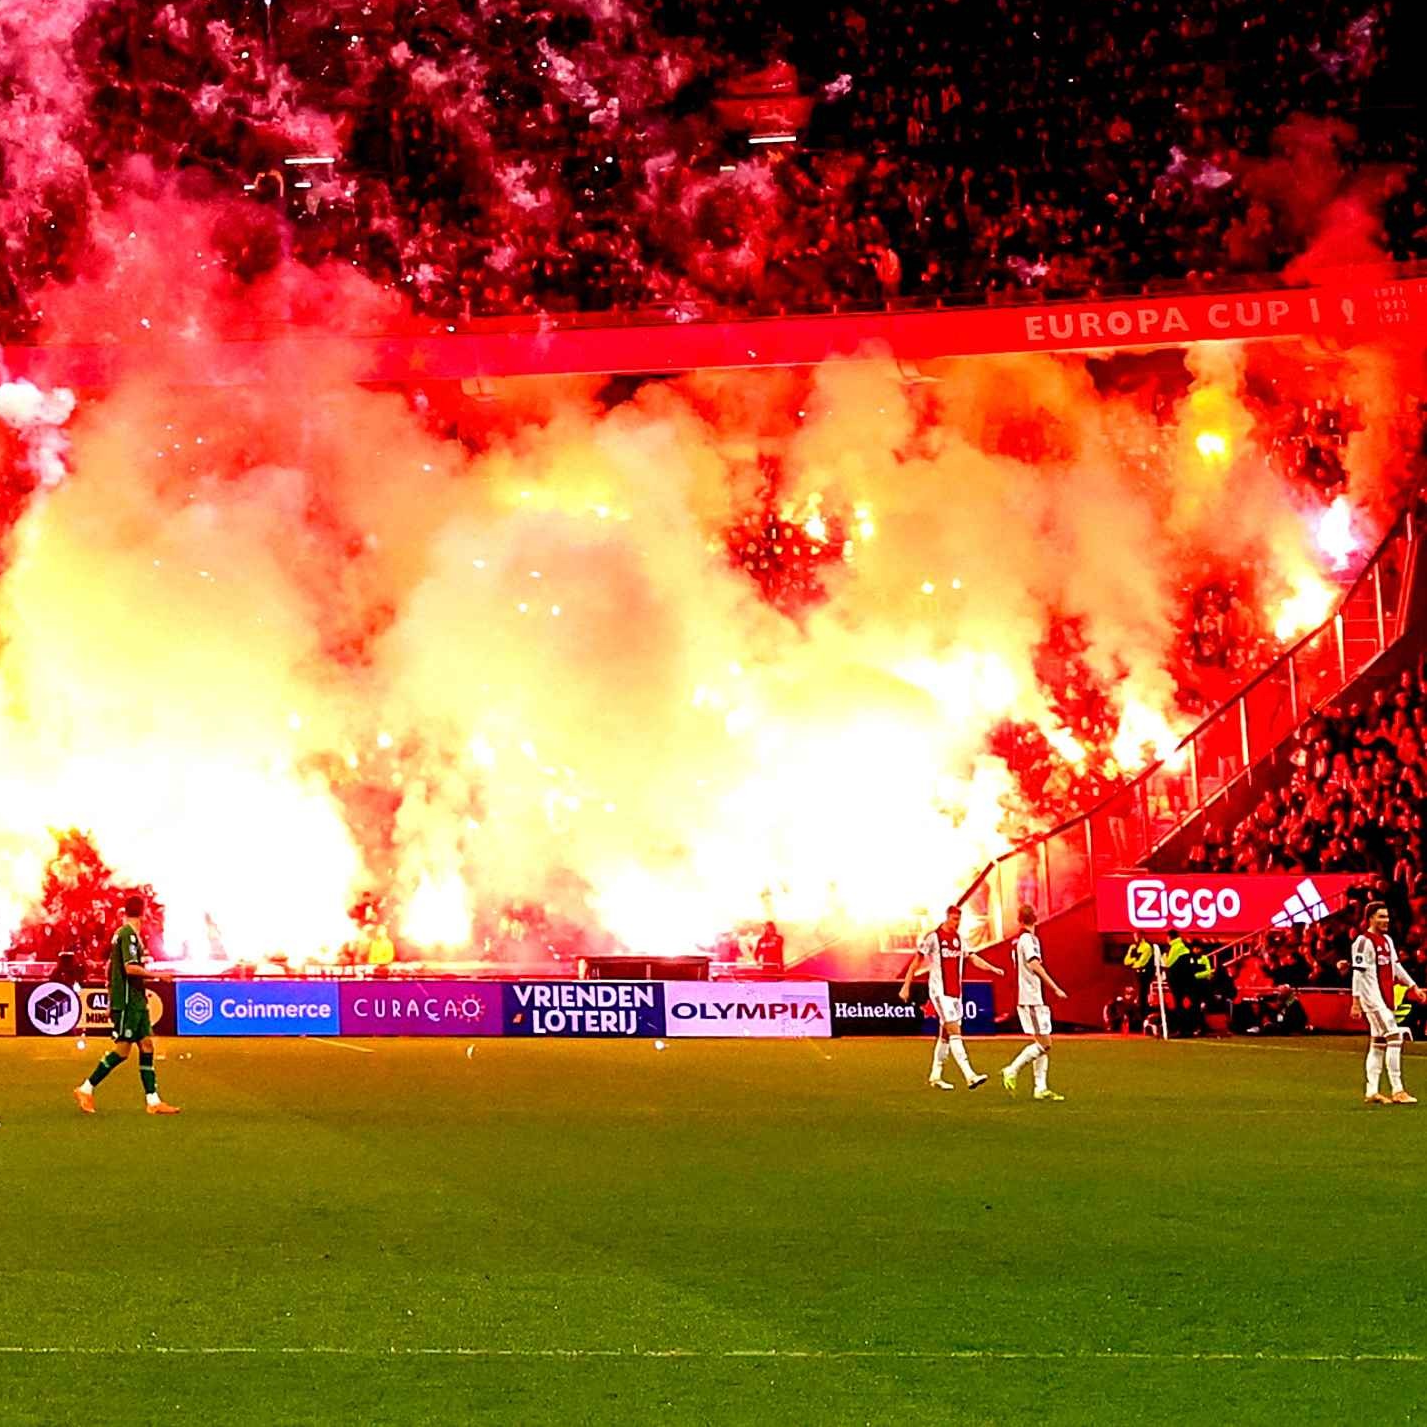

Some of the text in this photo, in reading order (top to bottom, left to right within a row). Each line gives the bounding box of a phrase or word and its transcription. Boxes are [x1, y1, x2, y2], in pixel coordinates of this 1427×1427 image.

[1024, 300, 1190, 342] EUROPA
[1207, 298, 1289, 329] CUP
[513, 985, 654, 1008] VRIENDEN
[220, 998, 331, 1019] Coinmerce
[353, 995, 484, 1022] CURAÇAO
[671, 1002, 824, 1020] OLYMPIA
[835, 1002, 916, 1019] Heineken
[532, 1010, 639, 1035] LOTERIJ
